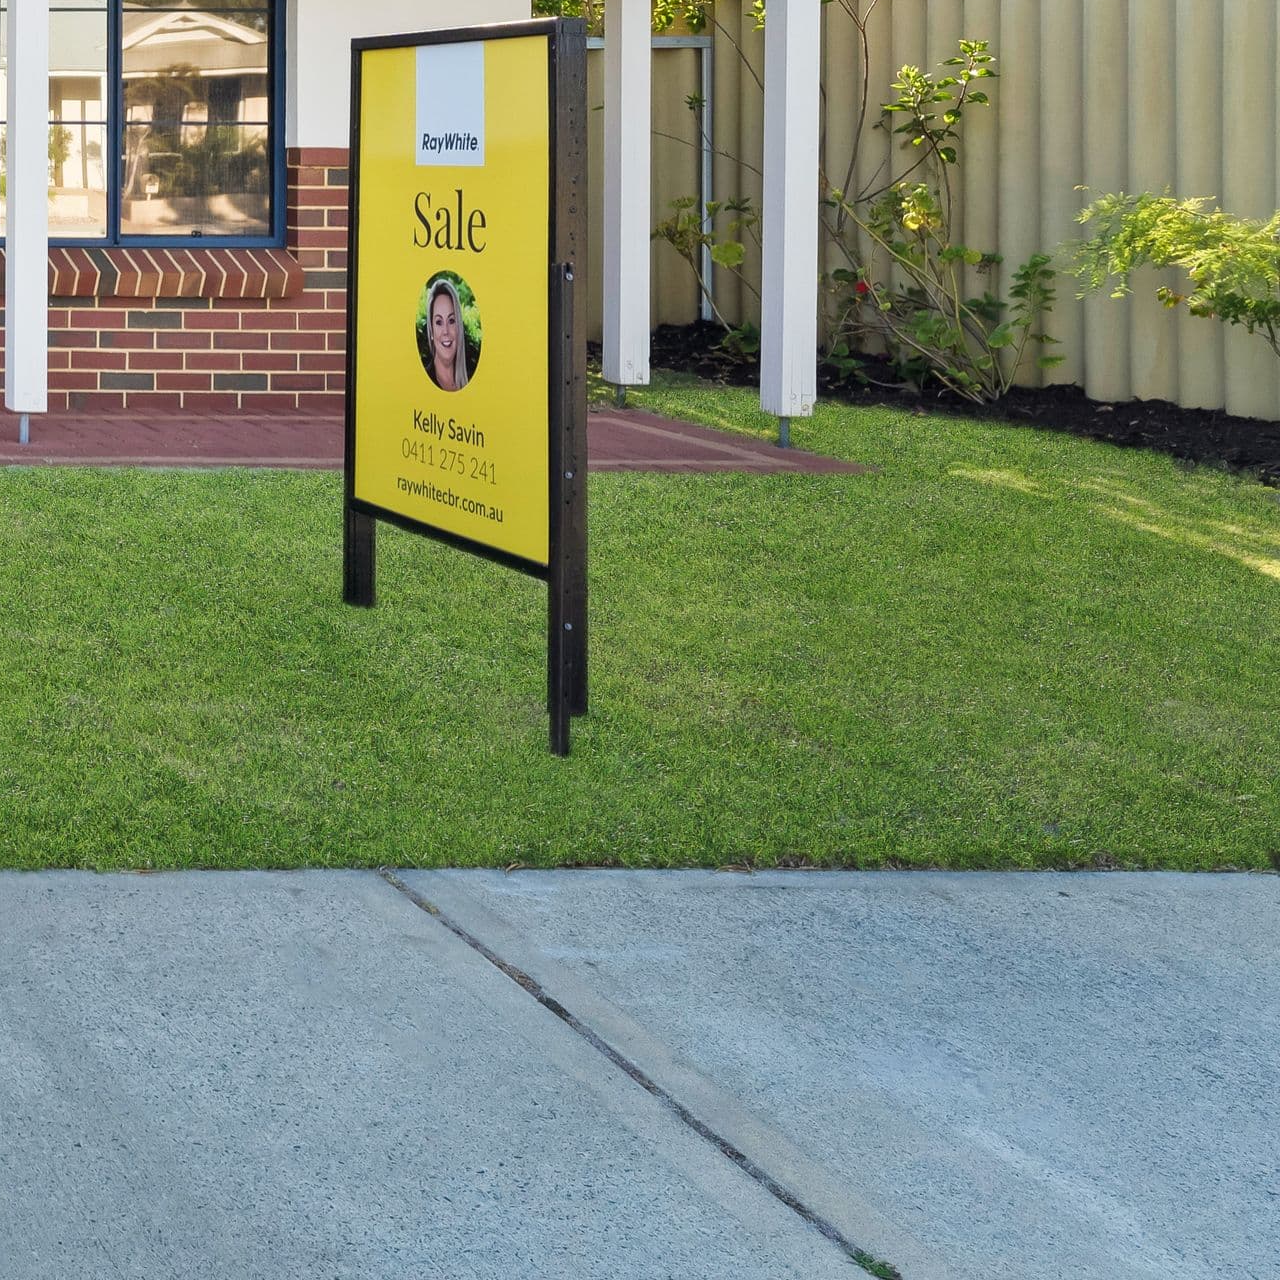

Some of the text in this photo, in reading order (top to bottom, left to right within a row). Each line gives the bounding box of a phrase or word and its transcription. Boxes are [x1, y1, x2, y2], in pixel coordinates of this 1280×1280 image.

[413, 188, 487, 253] Sale
[413, 408, 485, 448] Kelly Savin
[402, 438, 497, 486] 0411 275 241
[397, 476, 504, 523] raywhitecbr.com.au
